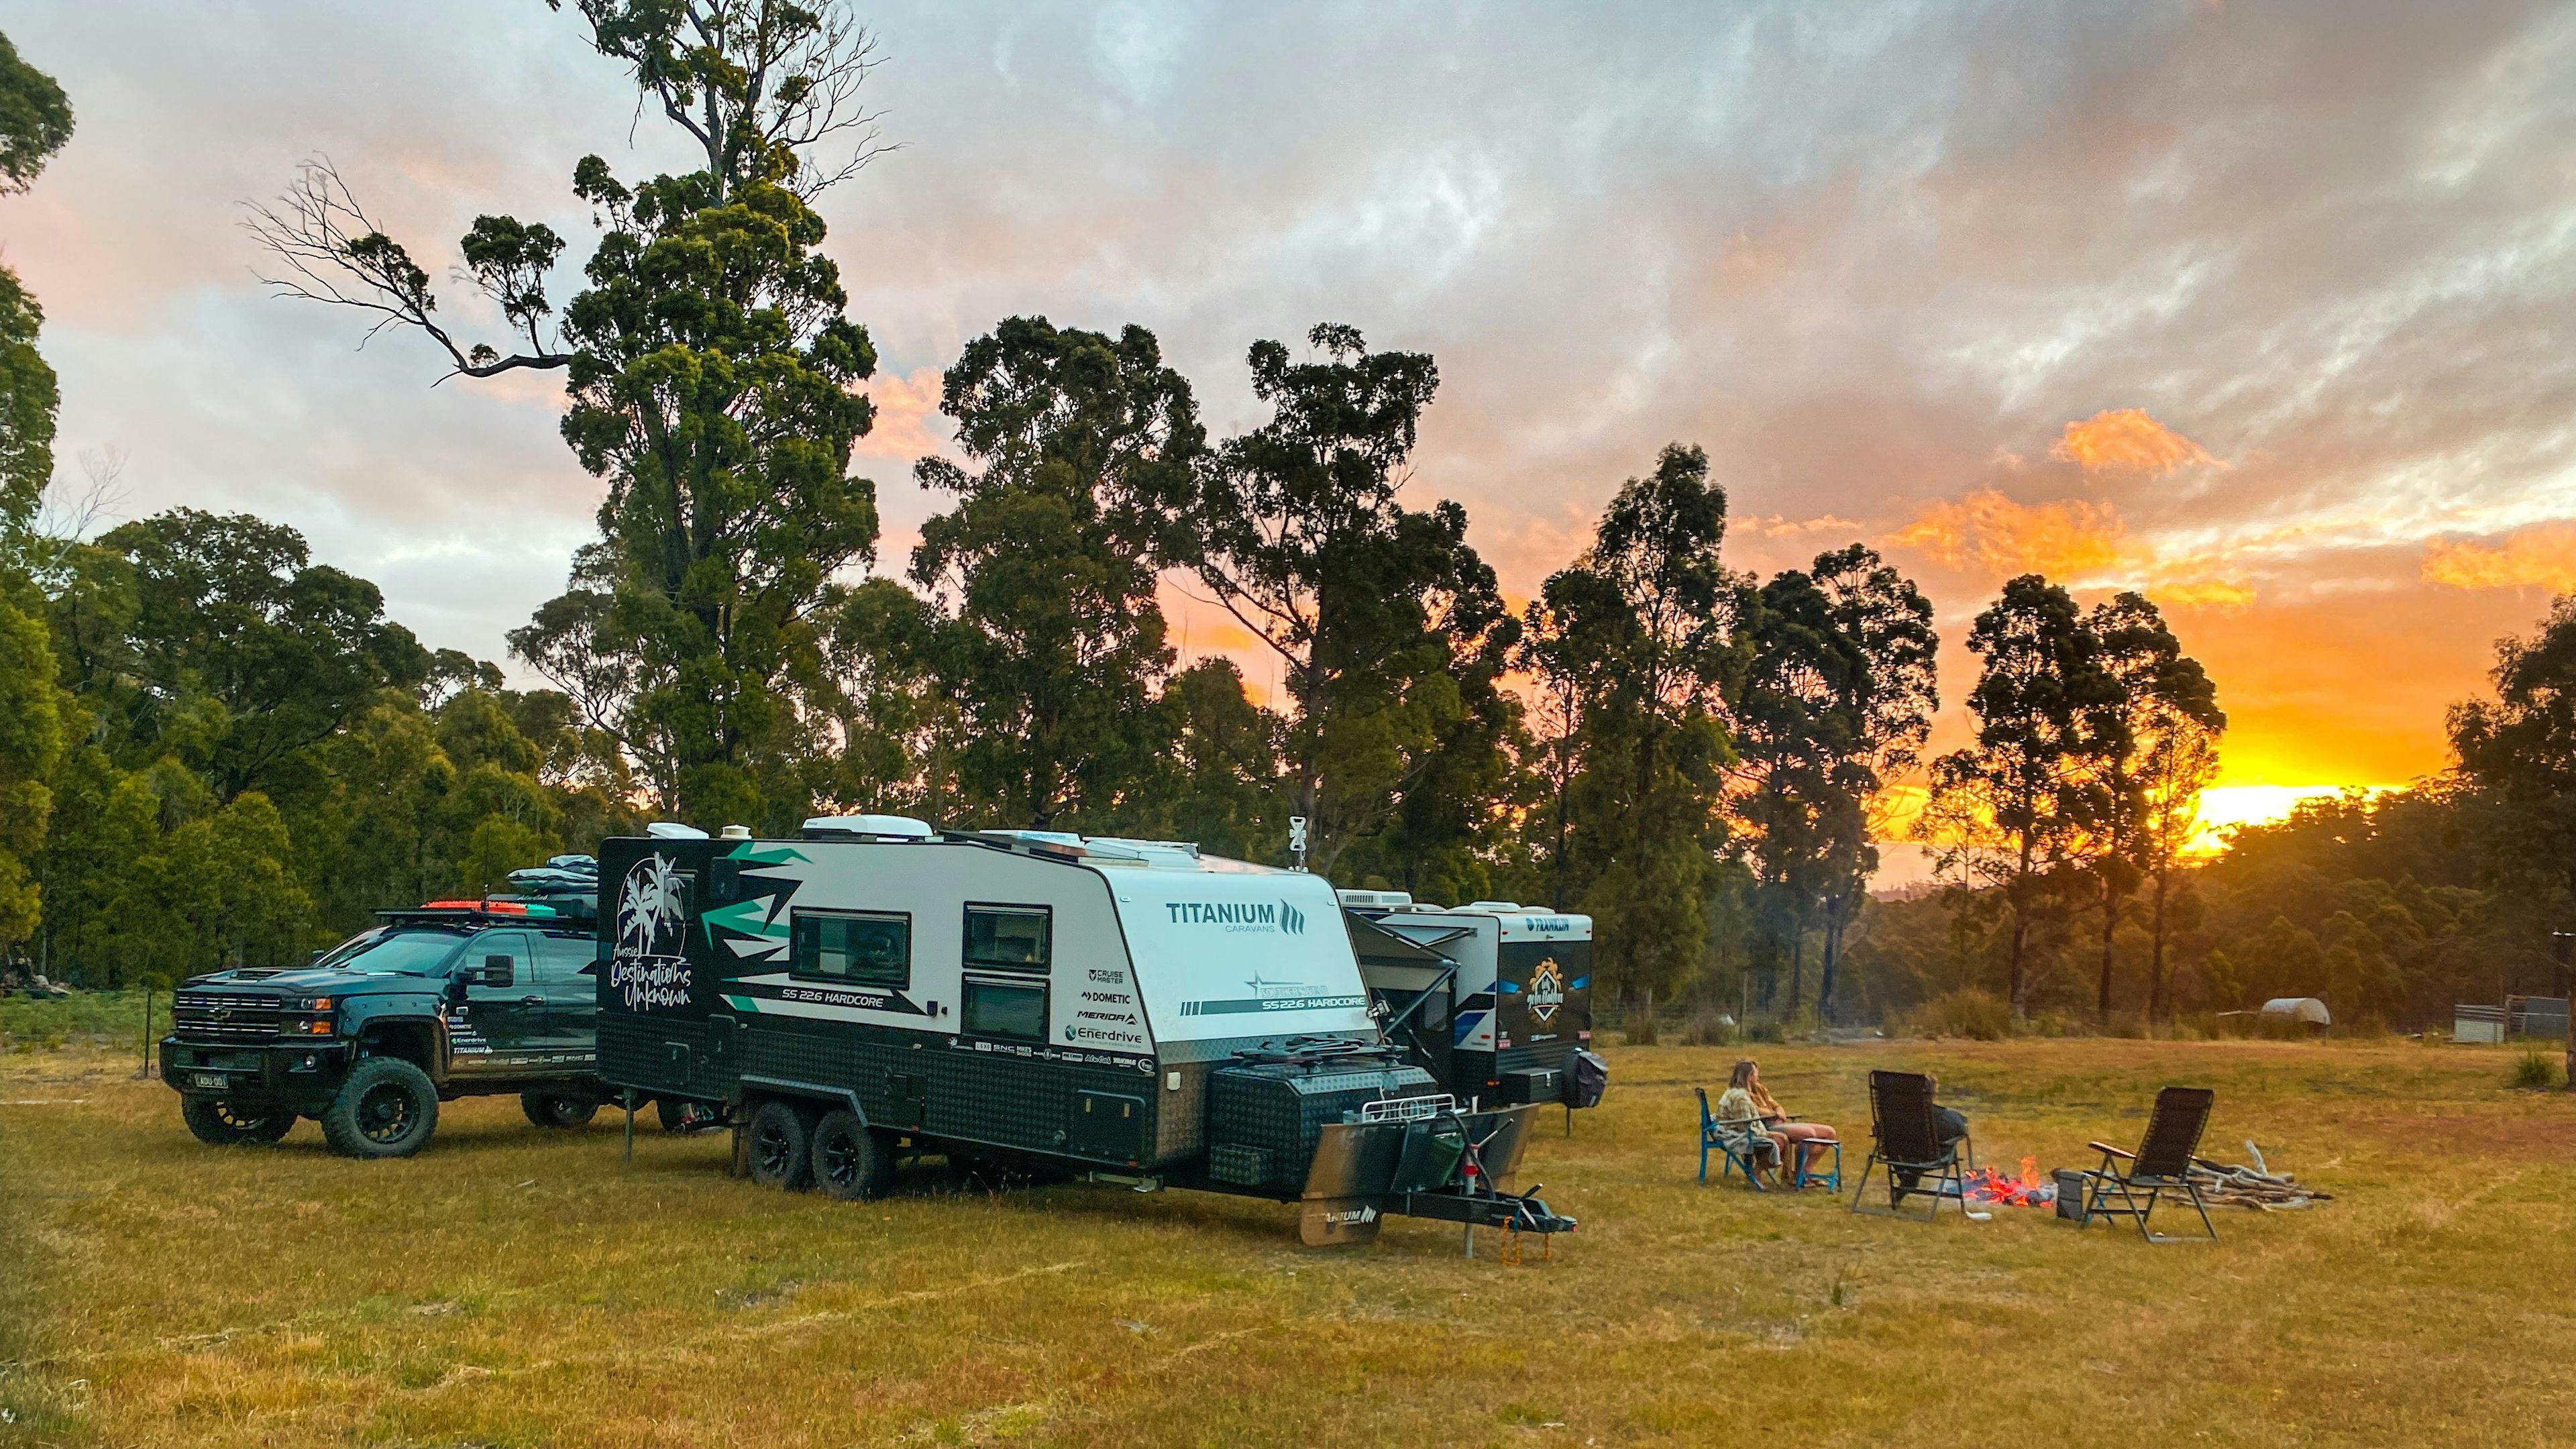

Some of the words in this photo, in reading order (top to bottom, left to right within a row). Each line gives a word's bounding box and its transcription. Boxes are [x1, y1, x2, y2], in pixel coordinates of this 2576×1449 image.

[1166, 903, 1275, 923] TITANIUM
[1225, 925, 1275, 933] CARAVANS
[613, 943, 638, 961] Aussie
[610, 958, 692, 990] Destinations
[625, 981, 692, 1011] Unknown
[782, 989, 798, 999] SS
[824, 993, 884, 1008] HARDCORE
[1093, 992, 1131, 1004] DOMETIC
[1307, 997, 1366, 1008] HARDCORE
[1077, 1011, 1126, 1022] MERIDA
[1077, 1028, 1142, 1043] Enerdrive
